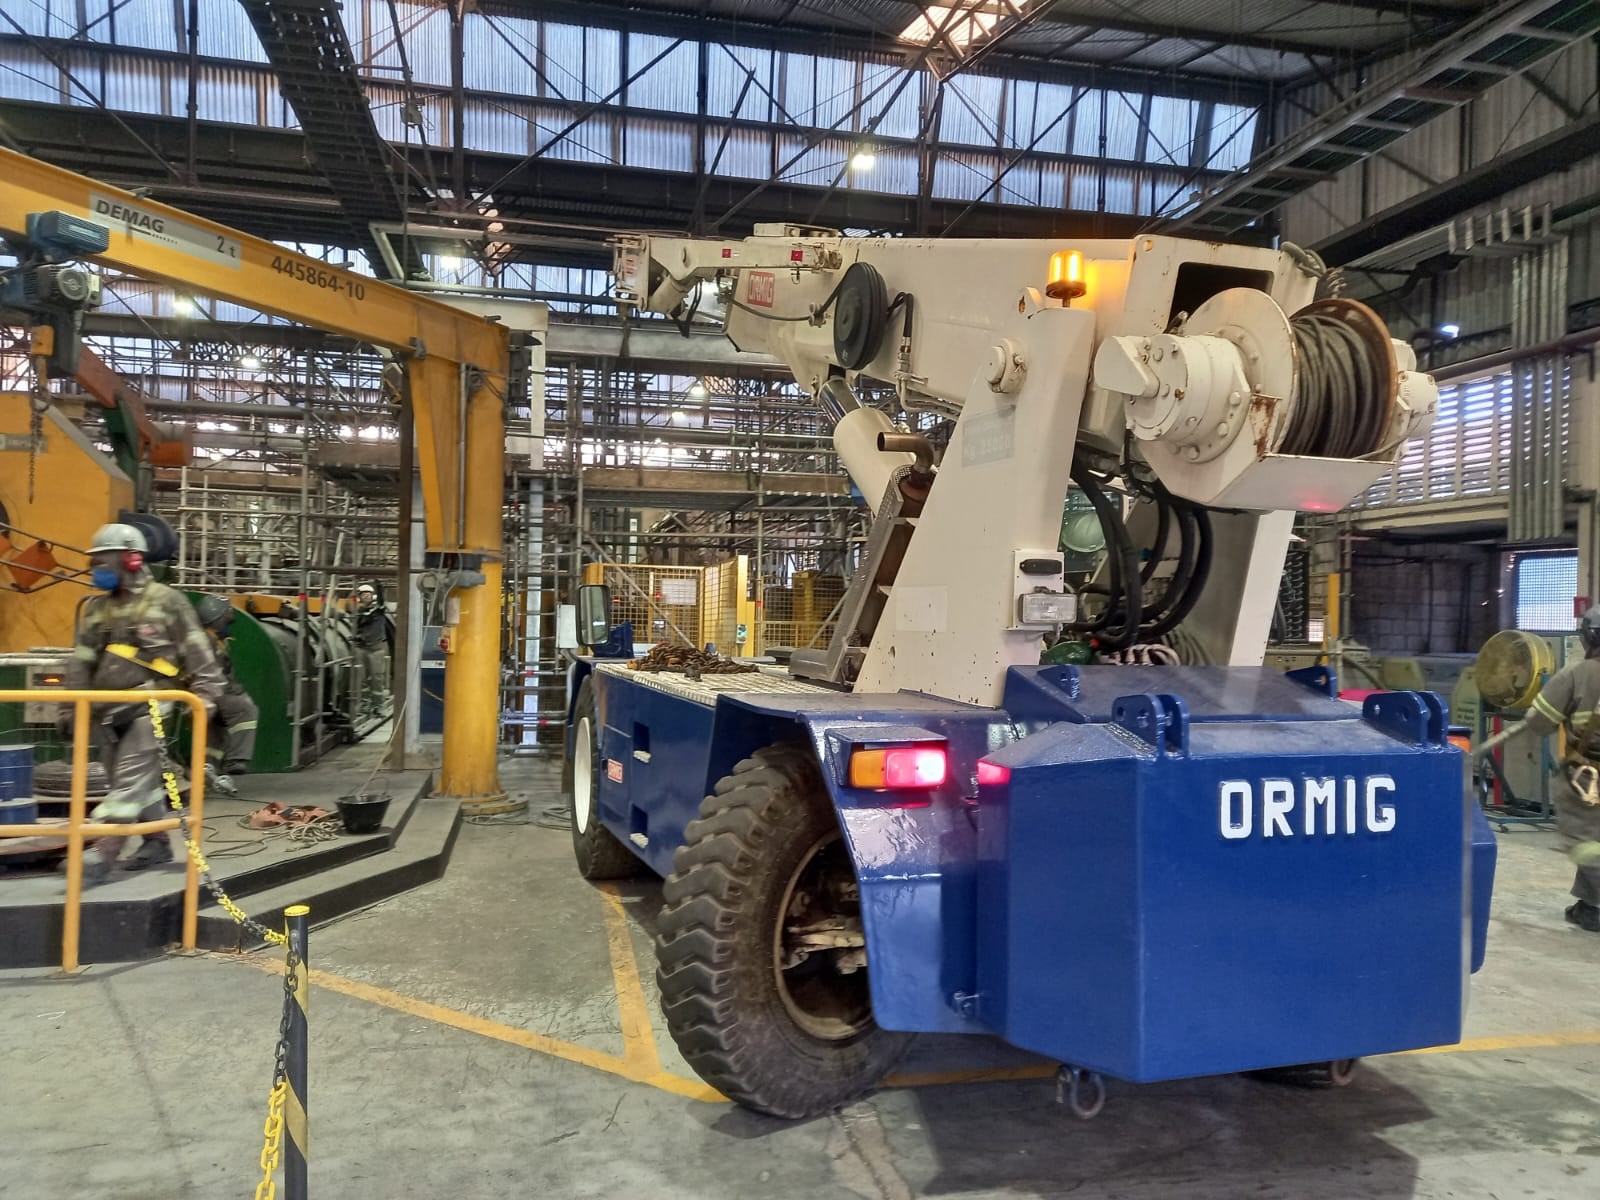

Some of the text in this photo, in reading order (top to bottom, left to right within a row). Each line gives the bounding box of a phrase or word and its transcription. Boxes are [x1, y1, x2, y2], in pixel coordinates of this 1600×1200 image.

[95, 199, 165, 234] DEMAG
[216, 235, 236, 258] 2 t
[271, 255, 365, 301] 445864-10
[1220, 776, 1396, 840] ORMIG
